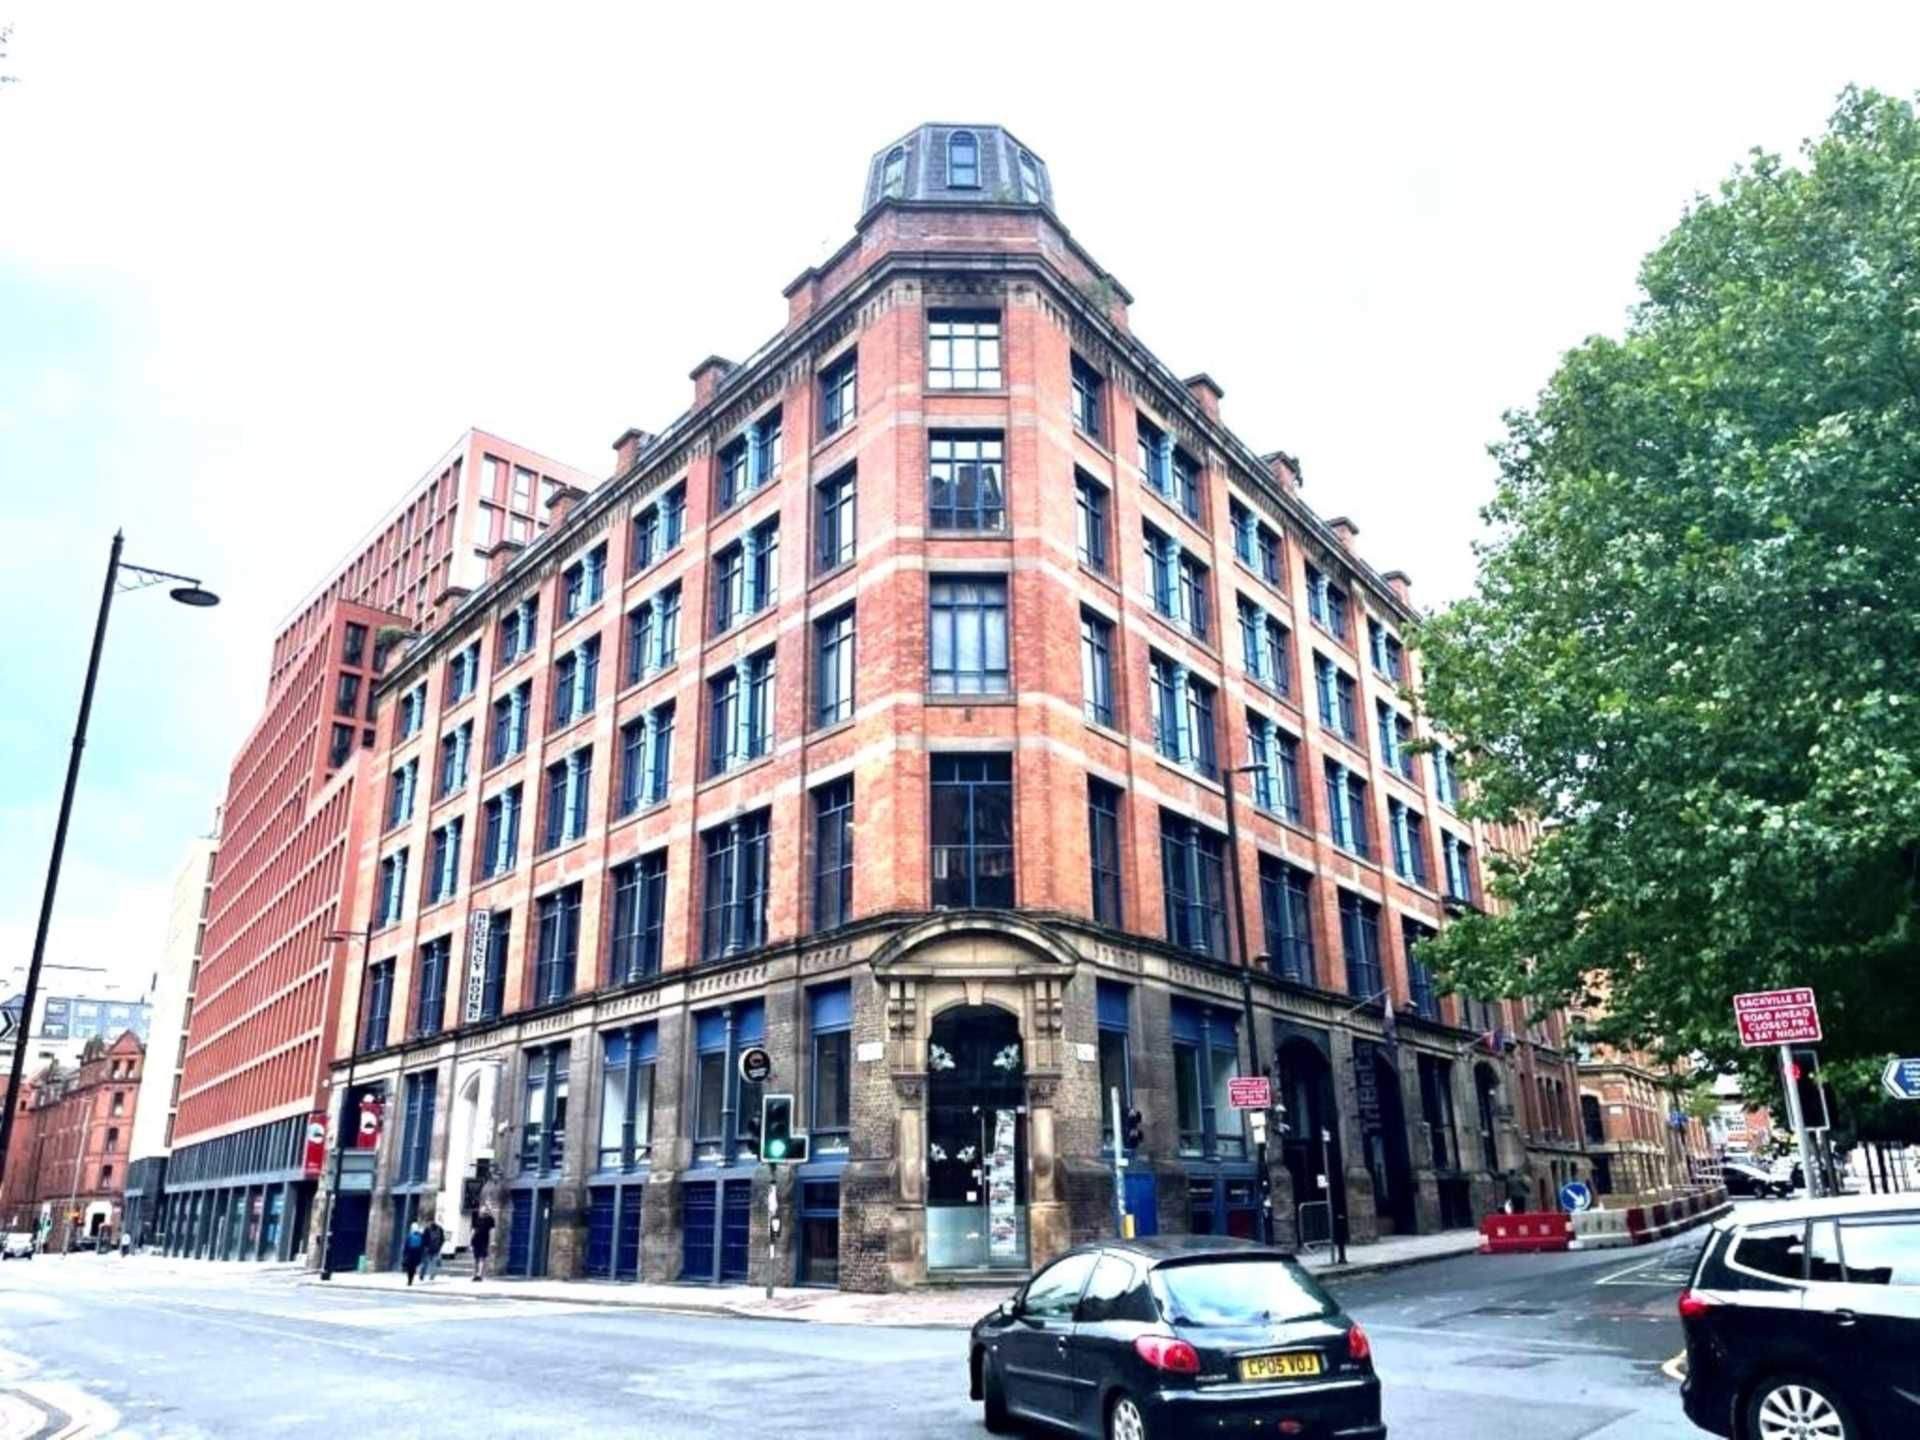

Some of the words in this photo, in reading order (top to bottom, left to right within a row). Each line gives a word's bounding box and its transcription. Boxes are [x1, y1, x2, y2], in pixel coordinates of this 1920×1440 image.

[1739, 994, 1793, 1008] SACKVILLE
[1795, 992, 1809, 1002] ST
[1742, 1012, 1772, 1022] ROAD
[1774, 1008, 1810, 1020] AHEAD
[1748, 1020, 1789, 1032] CLOSED
[1791, 1018, 1809, 1027] FRI
[1744, 1032, 1753, 1041] &
[1754, 1030, 1773, 1040] SAT
[1775, 1026, 1817, 1039] NIGHTS
